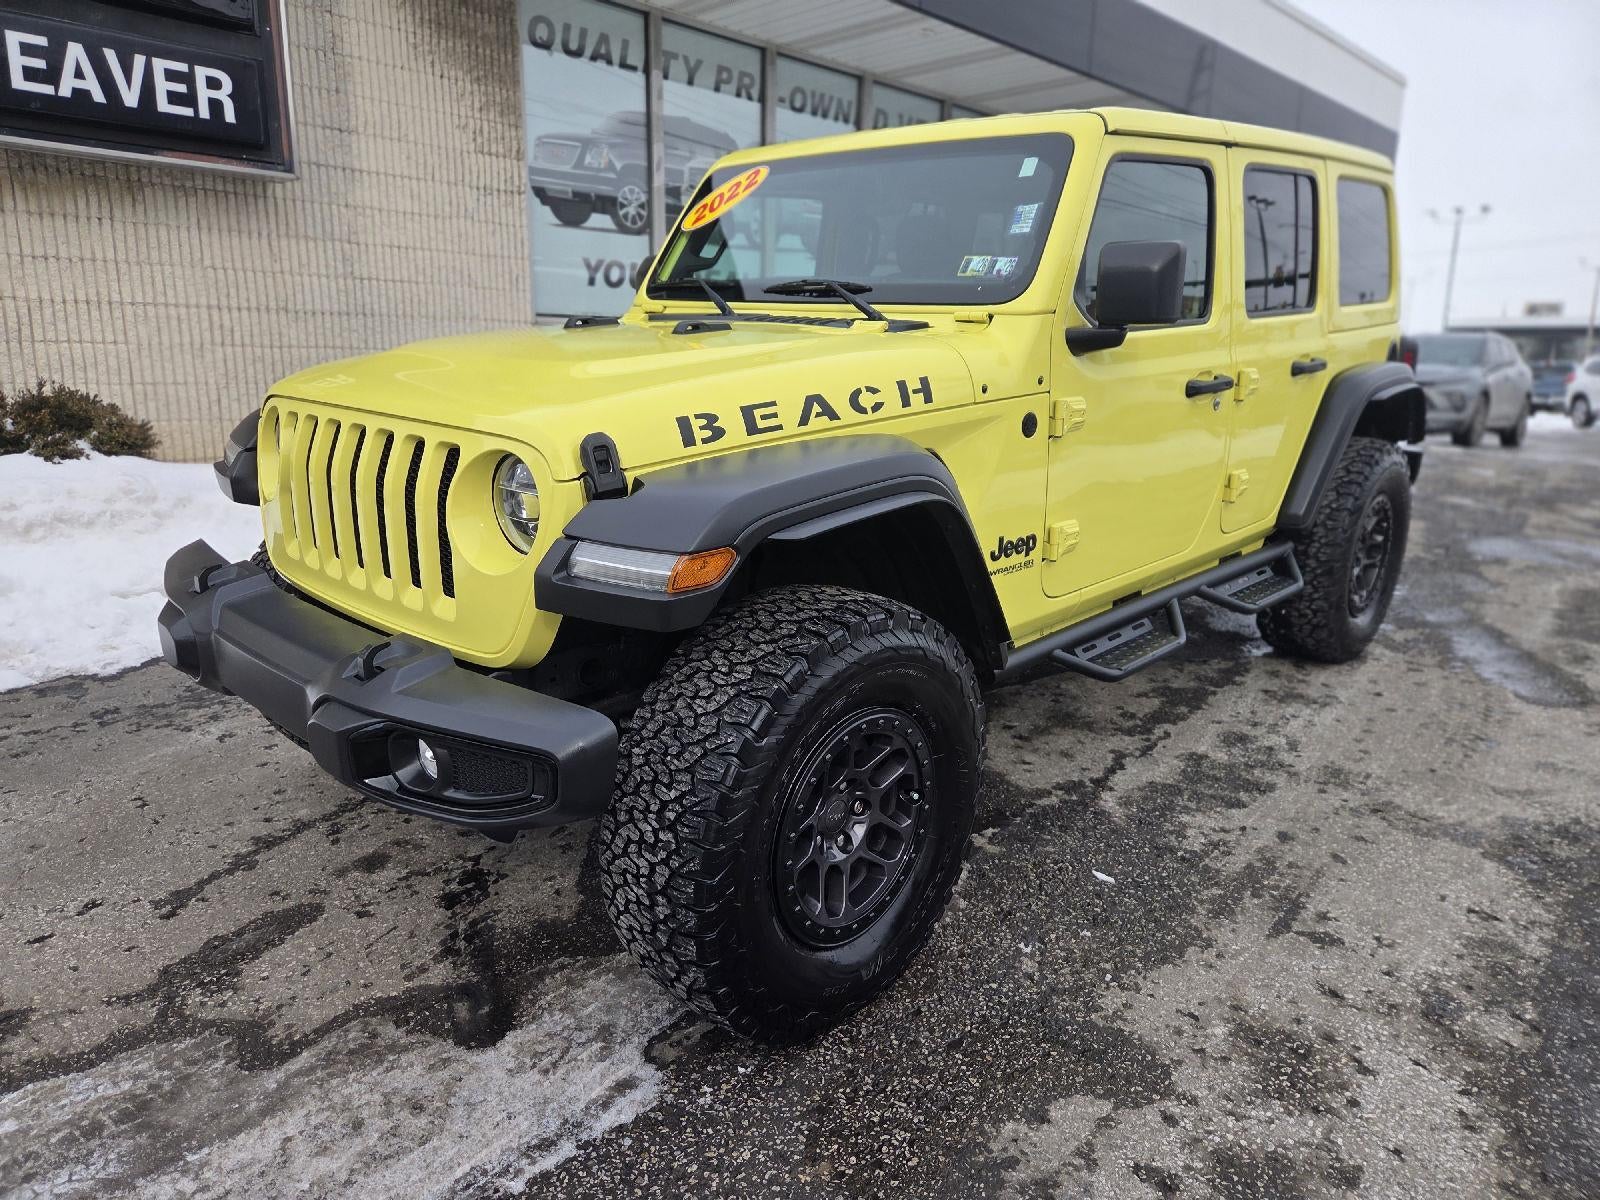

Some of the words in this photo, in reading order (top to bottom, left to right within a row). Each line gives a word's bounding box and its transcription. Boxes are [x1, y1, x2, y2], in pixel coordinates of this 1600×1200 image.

[527, 14, 704, 87] QUALTY
[691, 168, 761, 226] 2022
[675, 375, 934, 448] BEACH
[989, 558, 1034, 577] WRANGLER
[990, 533, 1037, 562] Jeep
